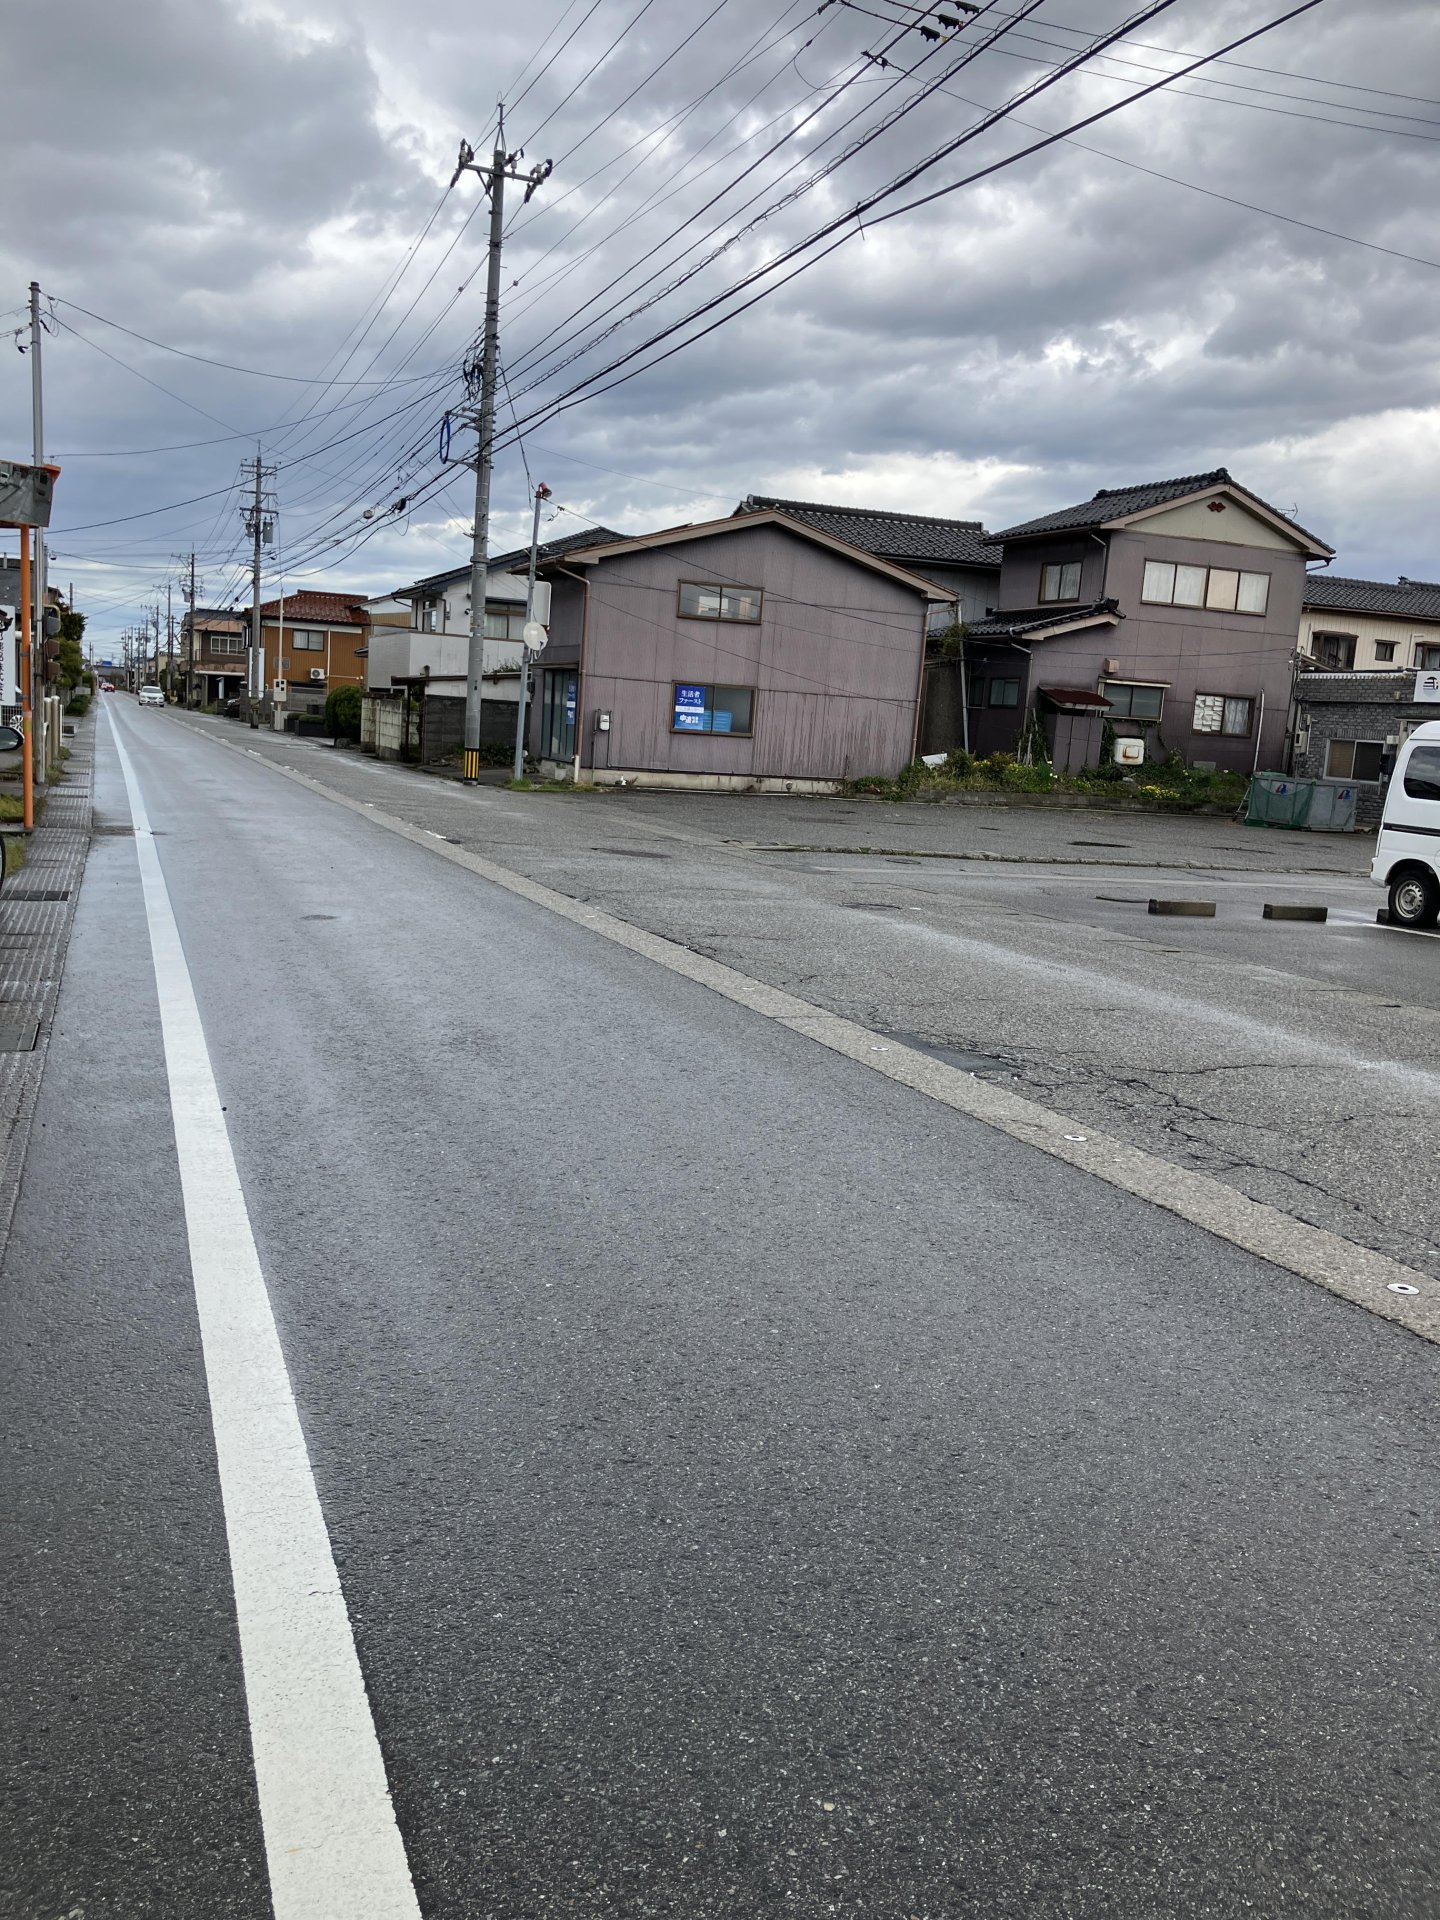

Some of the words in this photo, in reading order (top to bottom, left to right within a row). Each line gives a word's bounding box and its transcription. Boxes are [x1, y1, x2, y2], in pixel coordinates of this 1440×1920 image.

[677, 697, 702, 705] ファースト
